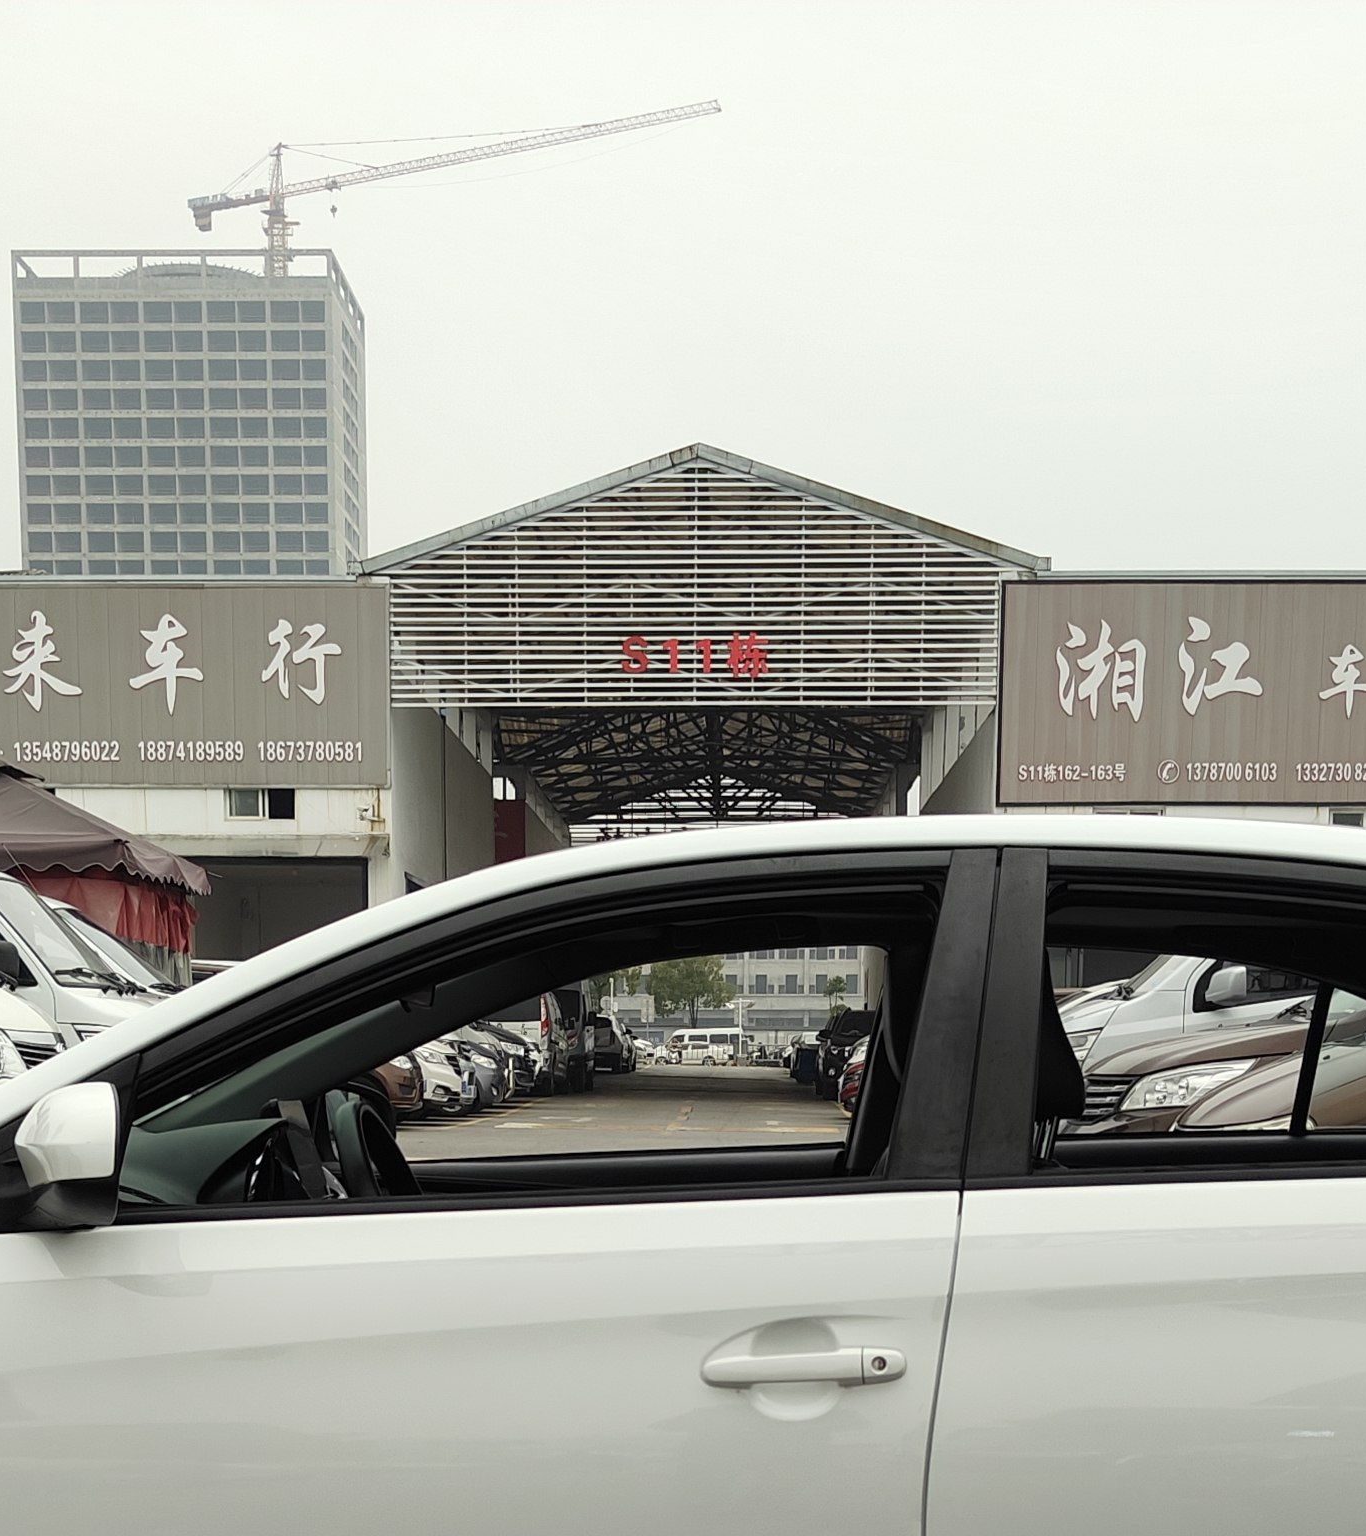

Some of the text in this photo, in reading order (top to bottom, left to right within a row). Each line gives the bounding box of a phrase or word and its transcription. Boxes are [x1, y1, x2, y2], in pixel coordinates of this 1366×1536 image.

[621, 632, 769, 678] S11栋
[13, 740, 120, 762] 13548796022
[137, 740, 244, 762] 18874189589
[257, 740, 363, 763] 18673780581
